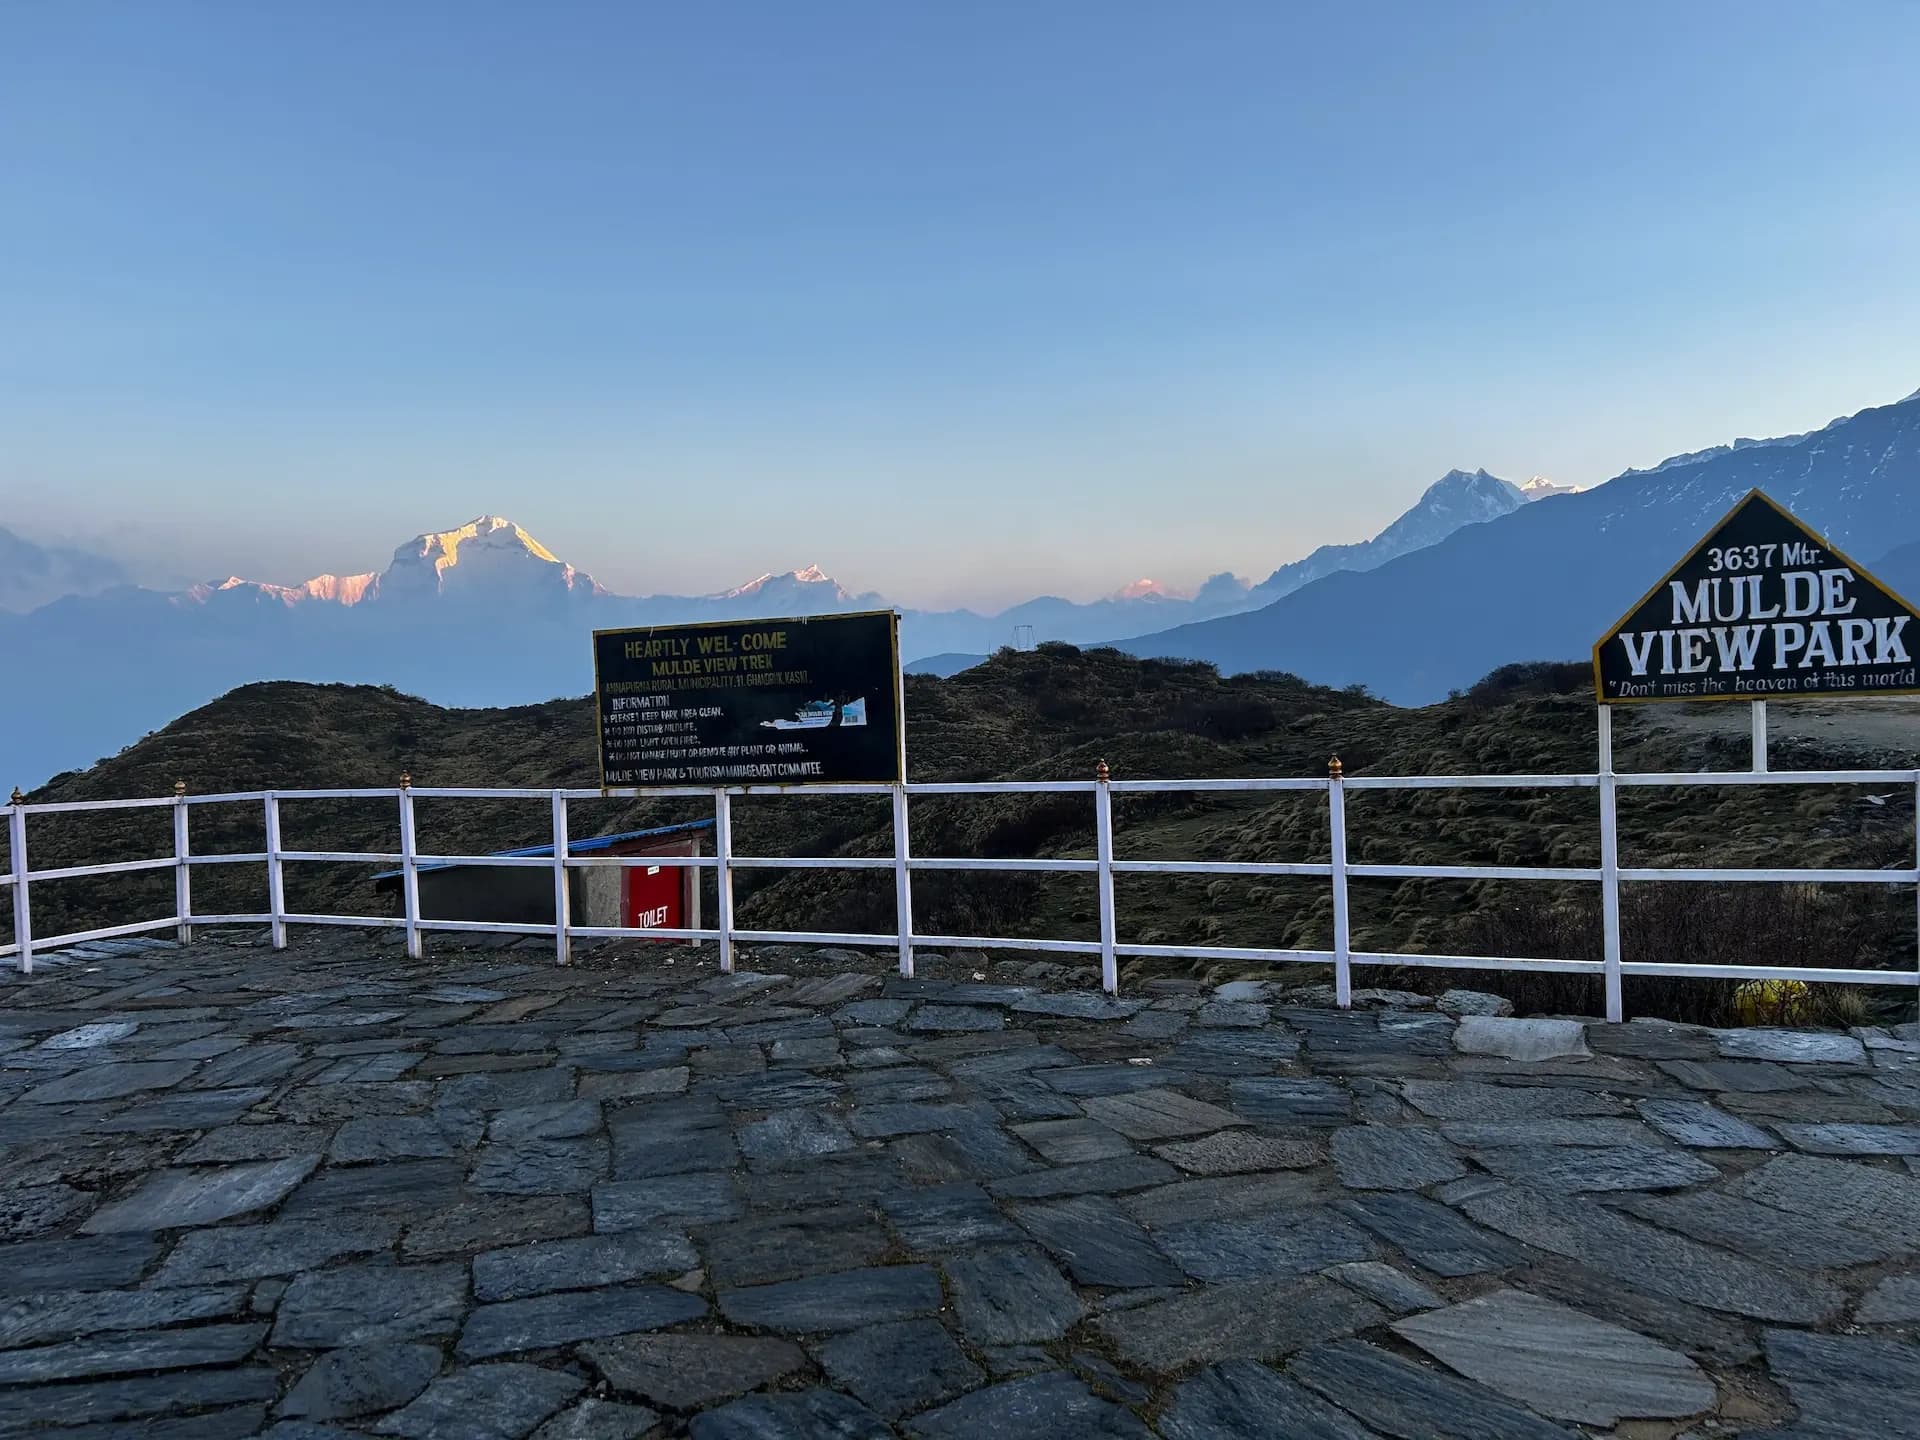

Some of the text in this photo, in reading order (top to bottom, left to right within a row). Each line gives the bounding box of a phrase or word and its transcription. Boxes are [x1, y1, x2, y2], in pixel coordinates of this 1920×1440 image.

[1707, 542, 1824, 572] 3637 Mtr.
[1669, 567, 1858, 625] MULDE
[624, 638, 690, 660] HEARTLY
[1619, 615, 1912, 677] VIEW PARK
[652, 654, 774, 677] MULDE VIEW TREK
[1663, 681, 1697, 695] miss
[1700, 677, 1727, 694] the
[1735, 675, 1798, 692] heaven
[1823, 671, 1855, 687] this
[1862, 667, 1916, 686] world
[612, 695, 670, 710] INFORMATION
[641, 711, 660, 722] KEEP
[661, 709, 679, 721] PARK
[740, 744, 764, 756] PLANT
[765, 743, 776, 754] OR
[606, 769, 633, 782] MULDE
[634, 768, 656, 781] VIEW
[656, 767, 678, 780] PARK
[686, 765, 725, 779] TOURISM
[638, 905, 668, 929] TOILET
